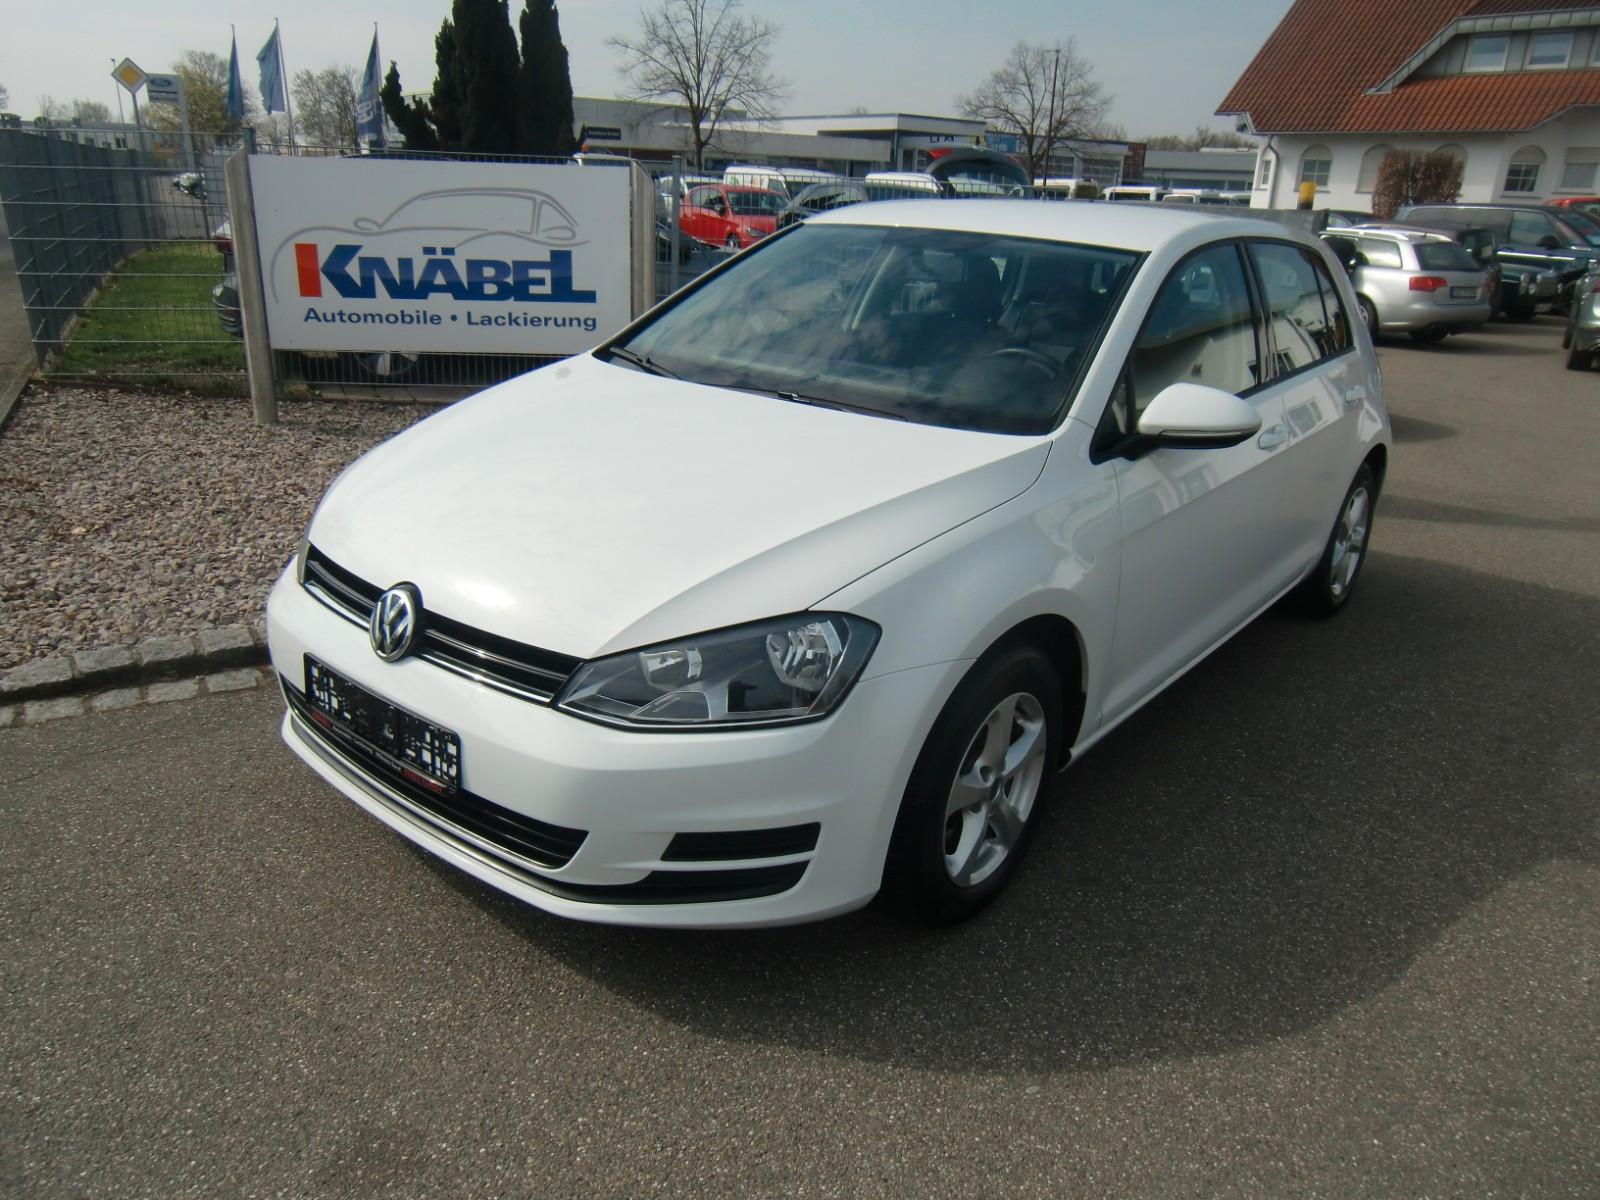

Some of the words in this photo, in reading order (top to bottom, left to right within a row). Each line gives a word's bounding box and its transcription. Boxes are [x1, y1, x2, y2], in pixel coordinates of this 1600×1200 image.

[295, 243, 597, 303] KNÄBEL
[303, 307, 443, 326] Automobile
[466, 311, 597, 332] Lackierung
